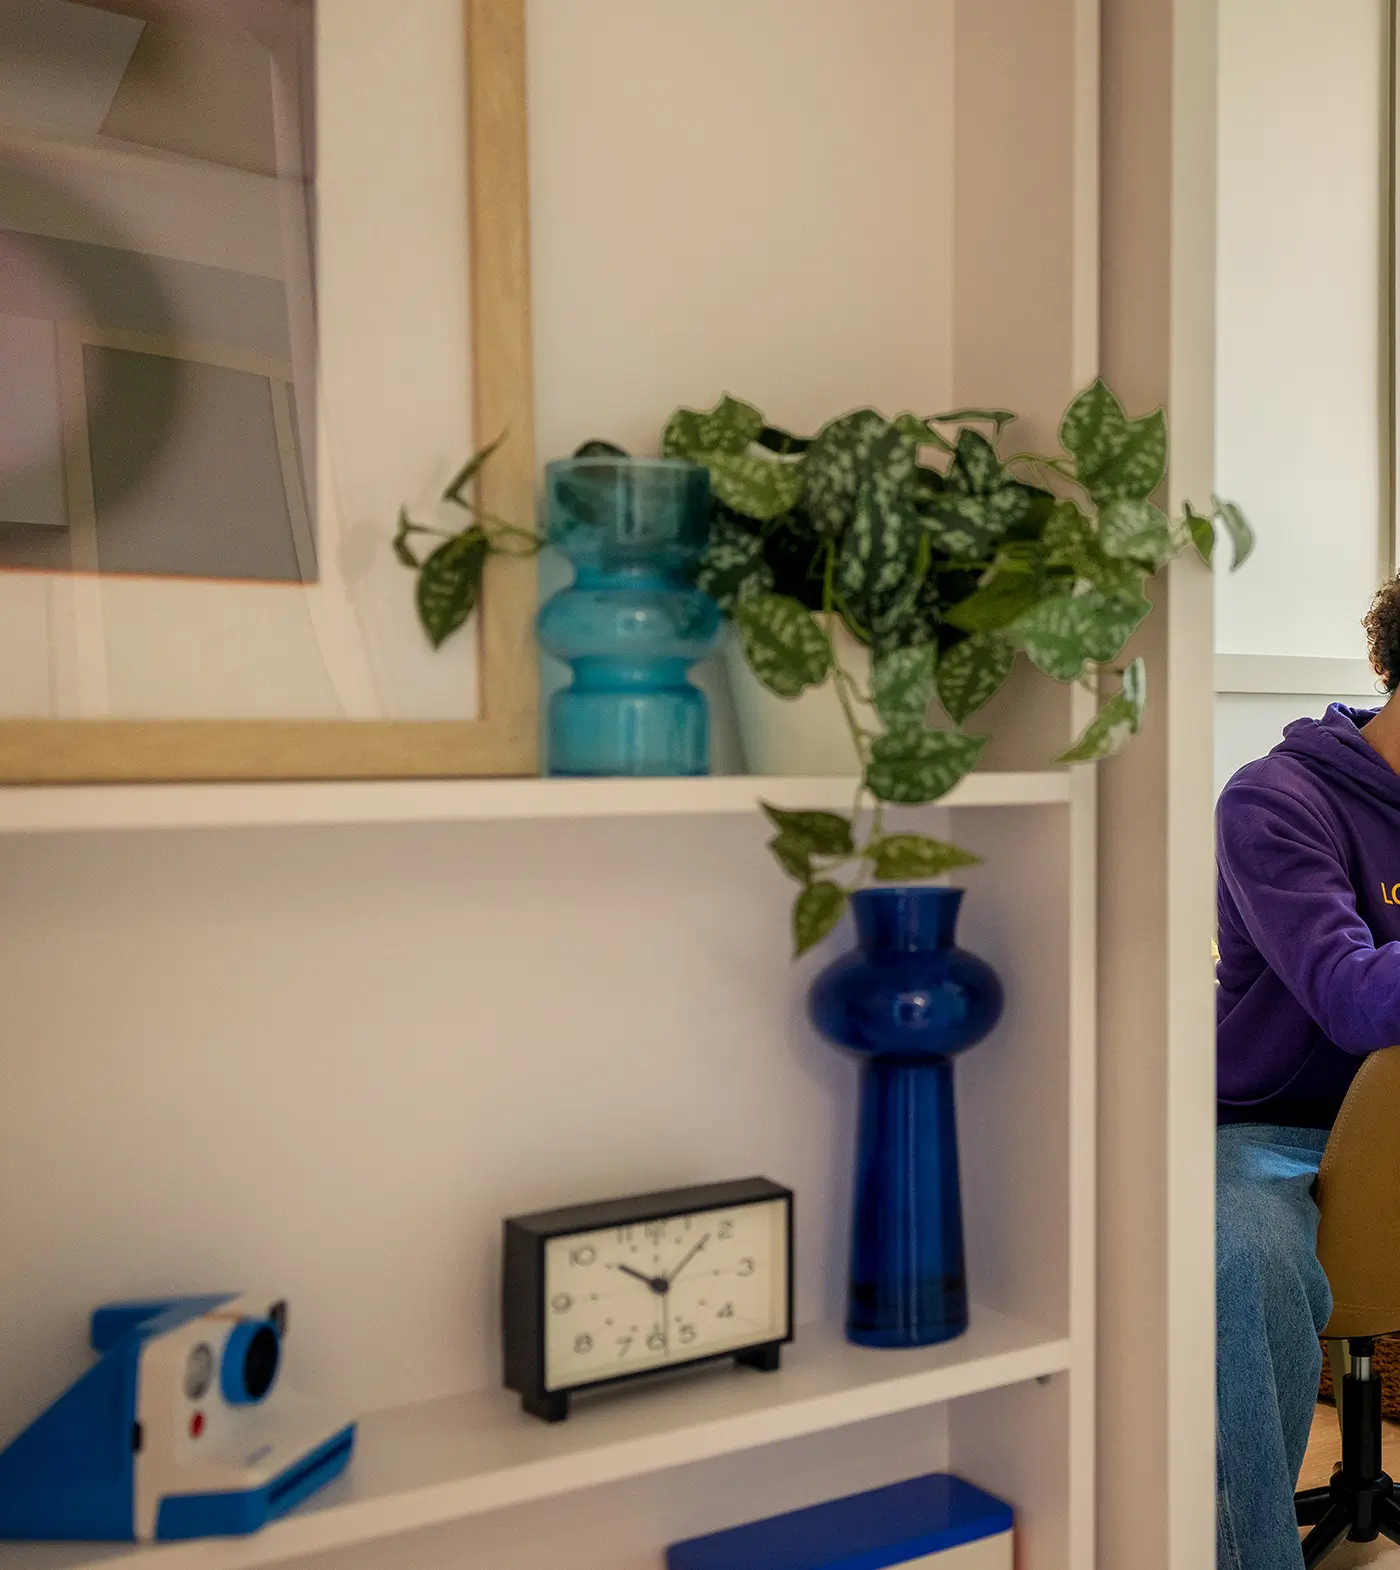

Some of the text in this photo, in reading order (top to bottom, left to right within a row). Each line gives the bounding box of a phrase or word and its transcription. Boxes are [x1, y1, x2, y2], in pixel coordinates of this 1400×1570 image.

[717, 1219, 734, 1240] 2
[736, 1256, 756, 1278] 3
[716, 1301, 734, 1319] 4
[679, 1324, 697, 1345] 5
[616, 1335, 633, 1357] 7
